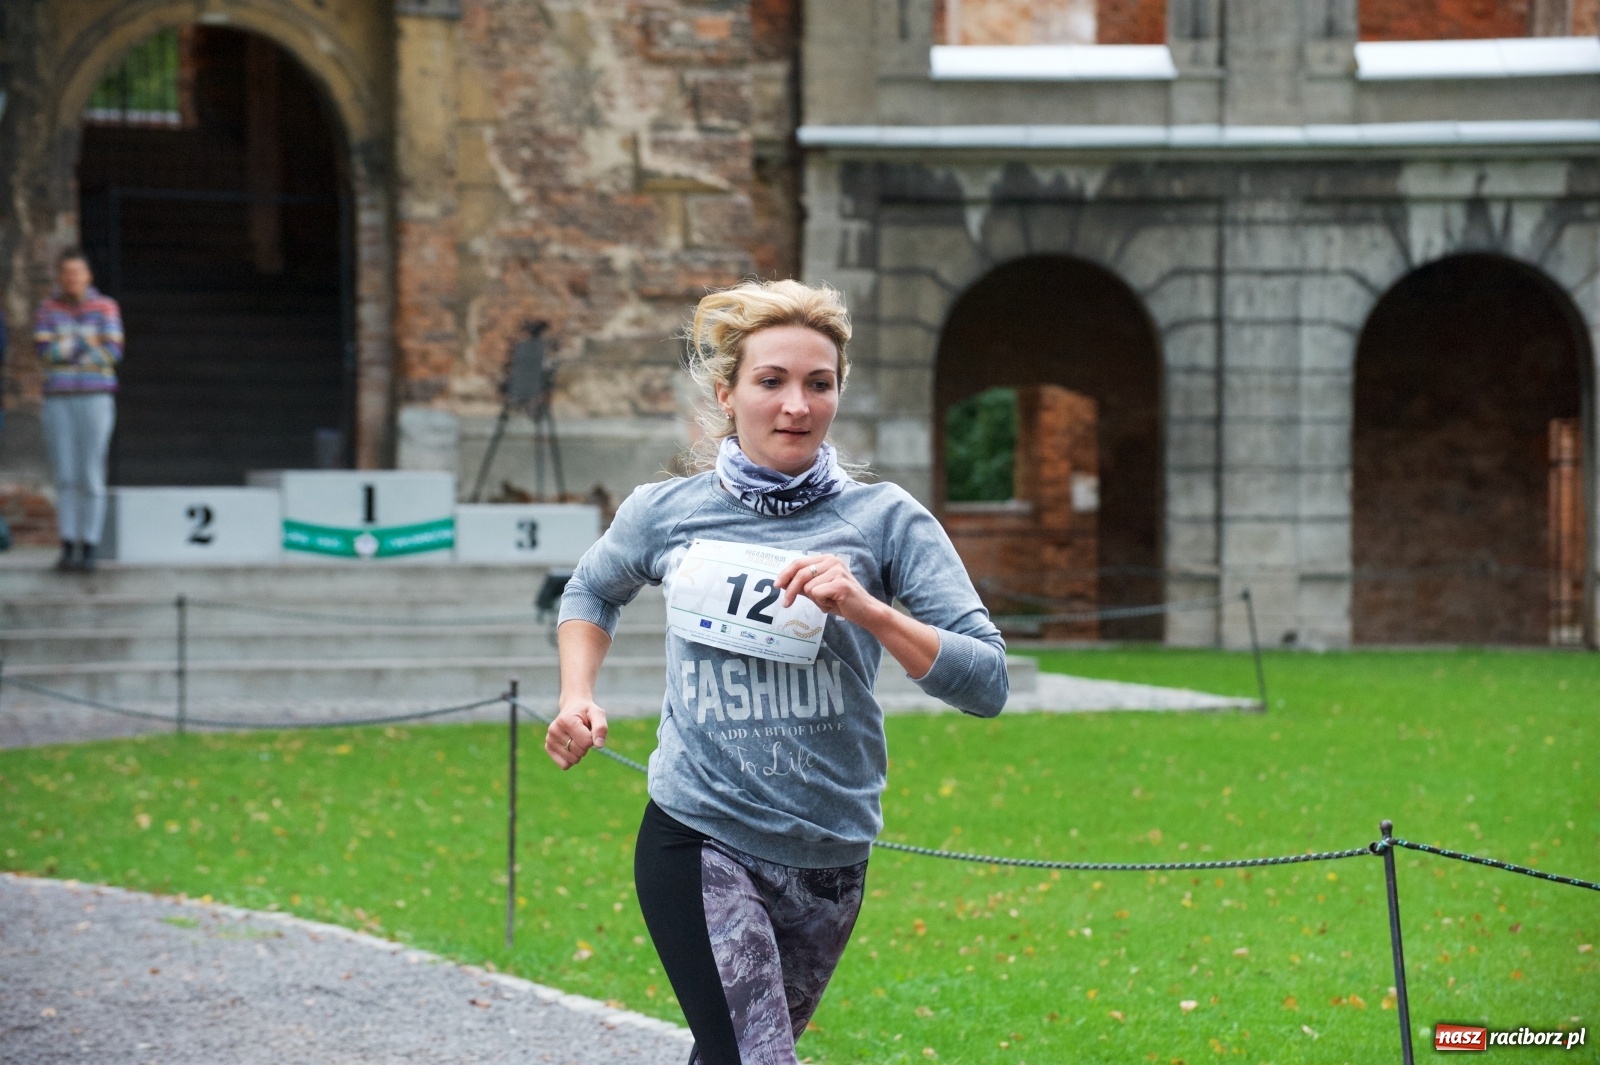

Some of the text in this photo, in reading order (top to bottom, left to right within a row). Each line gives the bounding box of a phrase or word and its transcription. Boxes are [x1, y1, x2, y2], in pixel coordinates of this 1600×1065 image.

[361, 484, 376, 523] 1
[186, 505, 214, 545] 2
[516, 519, 539, 550] 3
[726, 573, 781, 625] 12
[680, 658, 845, 724] FASHION
[720, 728, 748, 740] ADD
[751, 727, 761, 738] A
[765, 726, 786, 737] BIT
[788, 725, 805, 737] OF
[810, 722, 845, 735] LOVE
[721, 741, 819, 783] To Life
